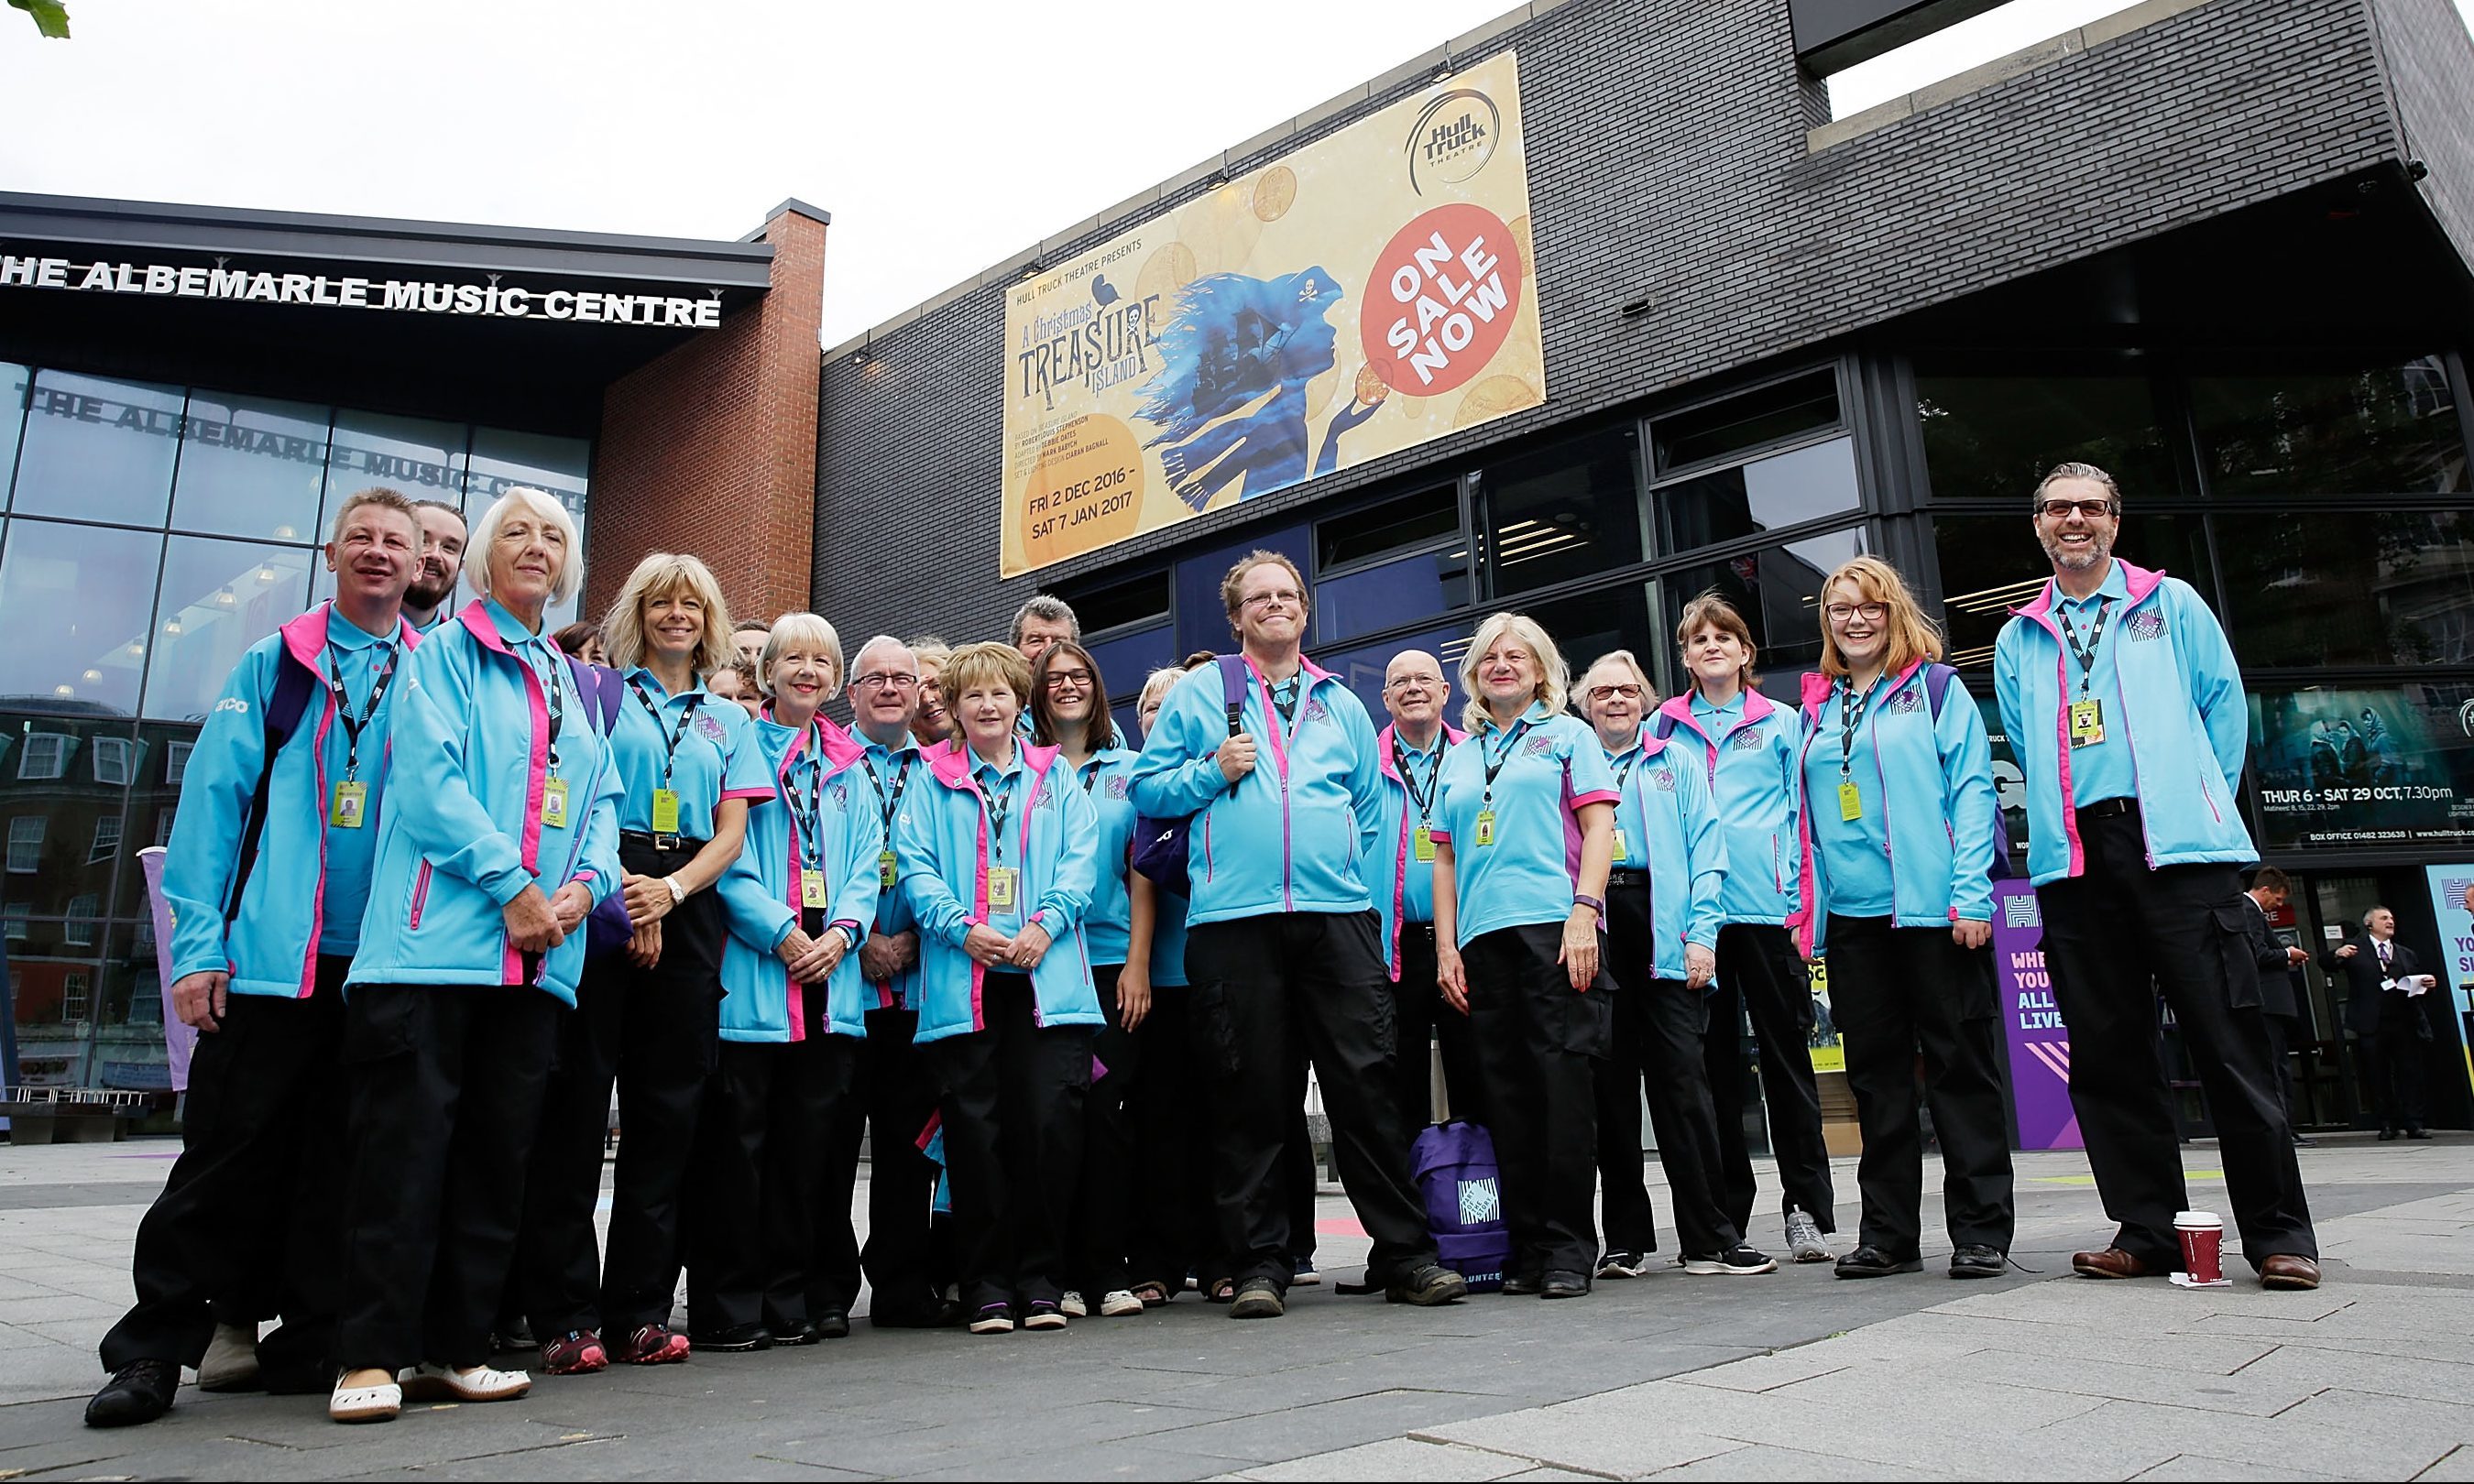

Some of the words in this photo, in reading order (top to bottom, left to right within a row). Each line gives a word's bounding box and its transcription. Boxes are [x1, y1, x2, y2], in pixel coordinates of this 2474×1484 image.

[1423, 124, 1486, 160] Truck
[1432, 114, 1472, 144] Hull
[1430, 141, 1483, 168] THEATRE
[1016, 290, 1035, 306] HULL
[1037, 277, 1063, 296] TRUCK
[1064, 259, 1100, 284] THEATRE
[1100, 238, 1142, 267] PRESENTS
[1389, 231, 1454, 303] ON
[0, 256, 70, 288] HE
[80, 261, 368, 306] ALBEMARLE
[384, 280, 531, 317] MUSIC
[543, 290, 722, 328] CENTRE
[1386, 235, 1499, 360] SALE
[1022, 324, 1030, 348] A
[1034, 300, 1093, 344] Christmas
[1409, 271, 1509, 386] NOW
[1018, 294, 1162, 411] TREASURE
[1091, 356, 1136, 398] ISLAND
[1022, 435, 1041, 447] ROBERT
[1040, 428, 1056, 440] LOUIS
[1056, 415, 1089, 434] STEPHENSON
[1041, 437, 1060, 449] DEBBIE
[1060, 430, 1077, 442] OATES
[1042, 448, 1056, 459] MARK
[1057, 440, 1078, 453] BABYCH
[1065, 448, 1085, 460] CIARAN
[1085, 438, 1109, 450] BAGNALL
[1029, 495, 1048, 515] FRI
[1053, 491, 1061, 507] 2
[1065, 480, 1090, 503] DEC
[1094, 467, 1126, 492] 2016
[1032, 518, 1056, 540] SAT
[1058, 514, 1067, 529] 7
[1070, 503, 1098, 526] JAN
[1101, 490, 1133, 516] 2017
[2261, 790, 2301, 803] THUR
[2303, 790, 2314, 802] 6
[2324, 788, 2348, 802] SAT
[2352, 788, 2371, 801] 29
[2373, 787, 2403, 801] OCT,
[2403, 786, 2453, 801] 7.30pm
[2310, 833, 2326, 841] BOX
[2326, 832, 2352, 840] OFFICE
[2353, 831, 2377, 840] 01482
[2377, 831, 2406, 839] 323638
[2013, 971, 2050, 989] YOU
[2018, 991, 2054, 1009] ALL
[1462, 1190, 1474, 1206] PART
[1467, 1201, 1474, 1210] OF
[1471, 1200, 1483, 1214] THE
[1463, 1270, 1503, 1284] LUNTEE
